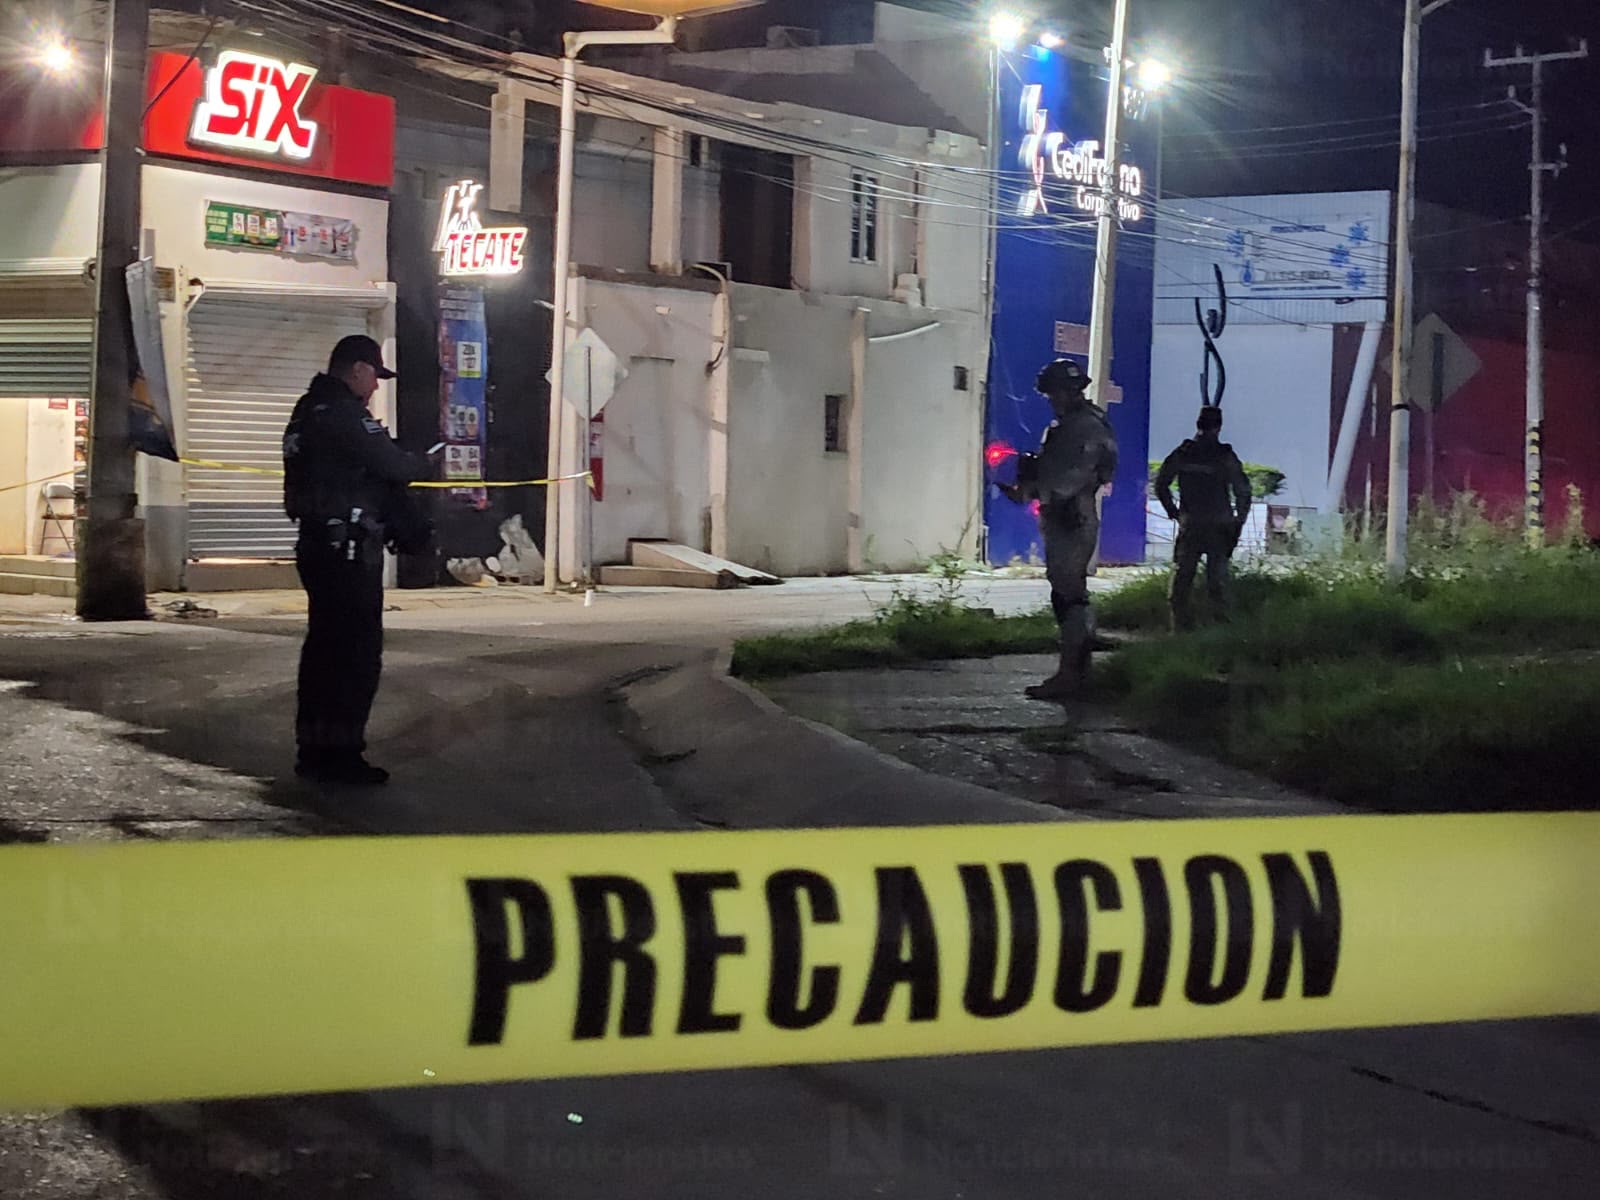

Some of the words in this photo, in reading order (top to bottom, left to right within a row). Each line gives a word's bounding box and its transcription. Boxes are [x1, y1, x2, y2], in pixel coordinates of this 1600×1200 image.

[1077, 185, 1140, 221] Corptivo
[446, 231, 524, 270] TECATE
[465, 850, 1343, 1047] PRECAUCION
